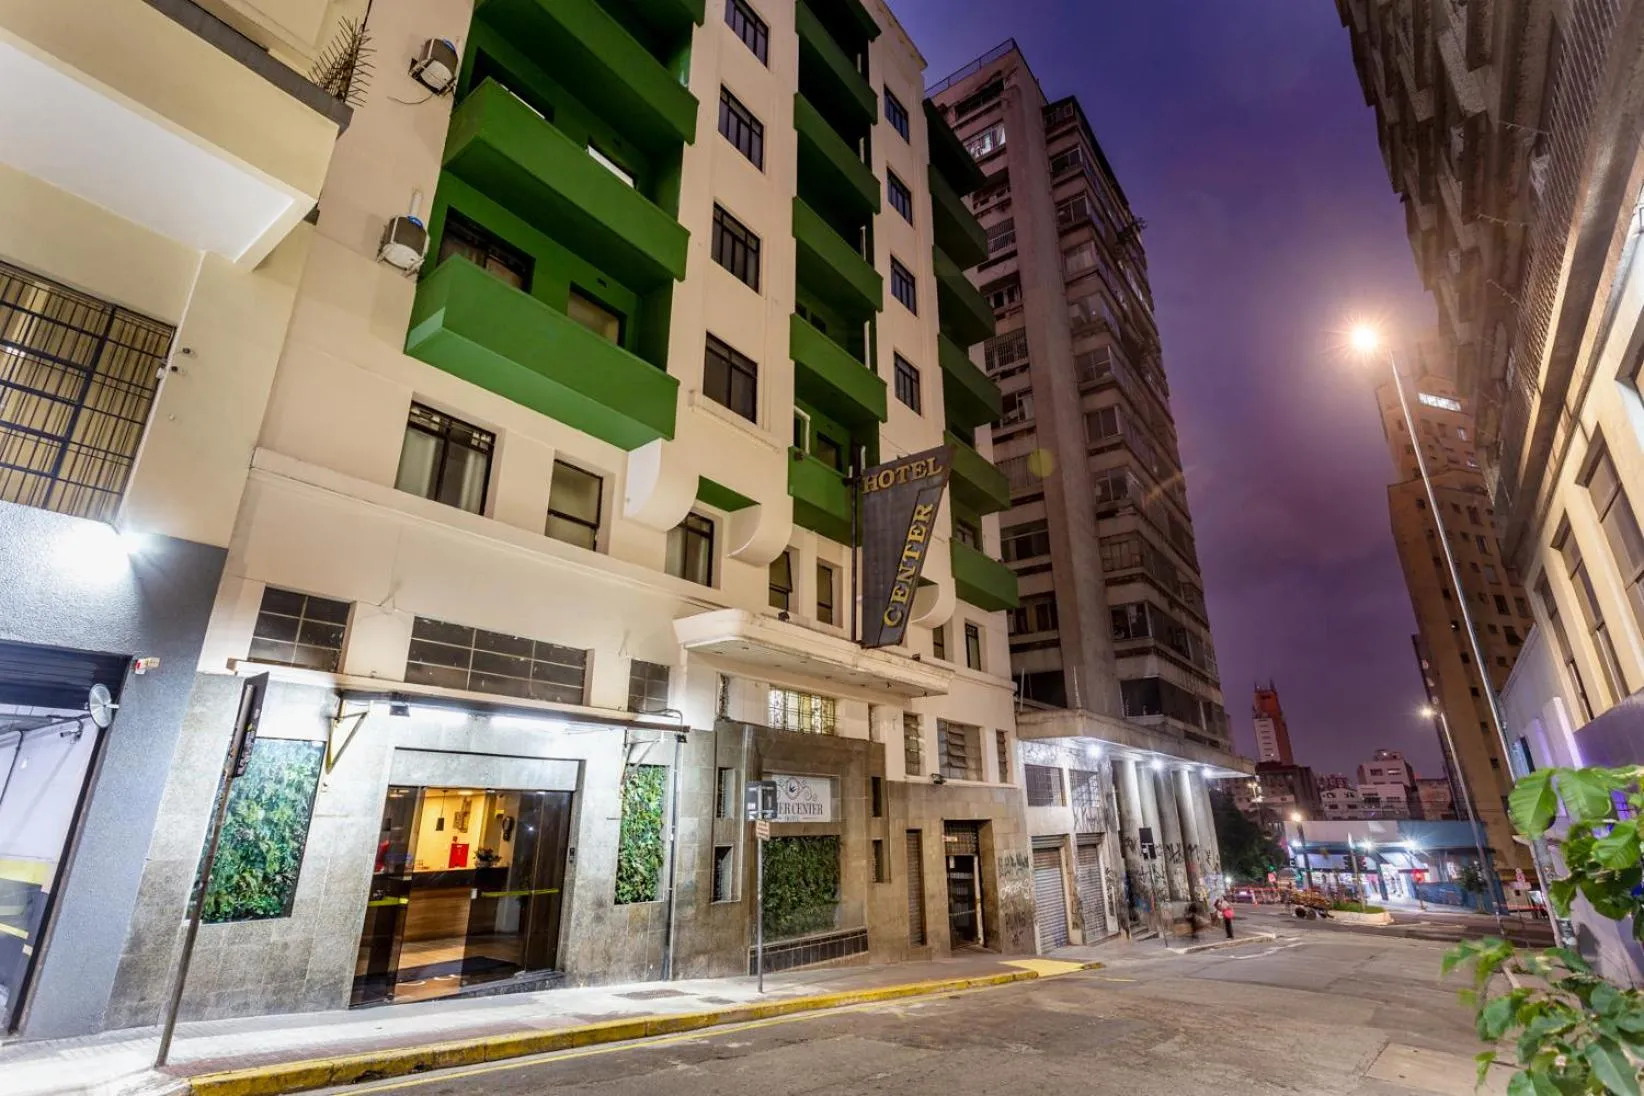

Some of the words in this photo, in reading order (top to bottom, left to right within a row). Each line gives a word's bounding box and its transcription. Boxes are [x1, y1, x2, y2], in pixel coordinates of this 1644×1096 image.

[862, 456, 943, 494] HOTEL
[883, 503, 934, 627] CENTER
[791, 802, 823, 816] CENTER
